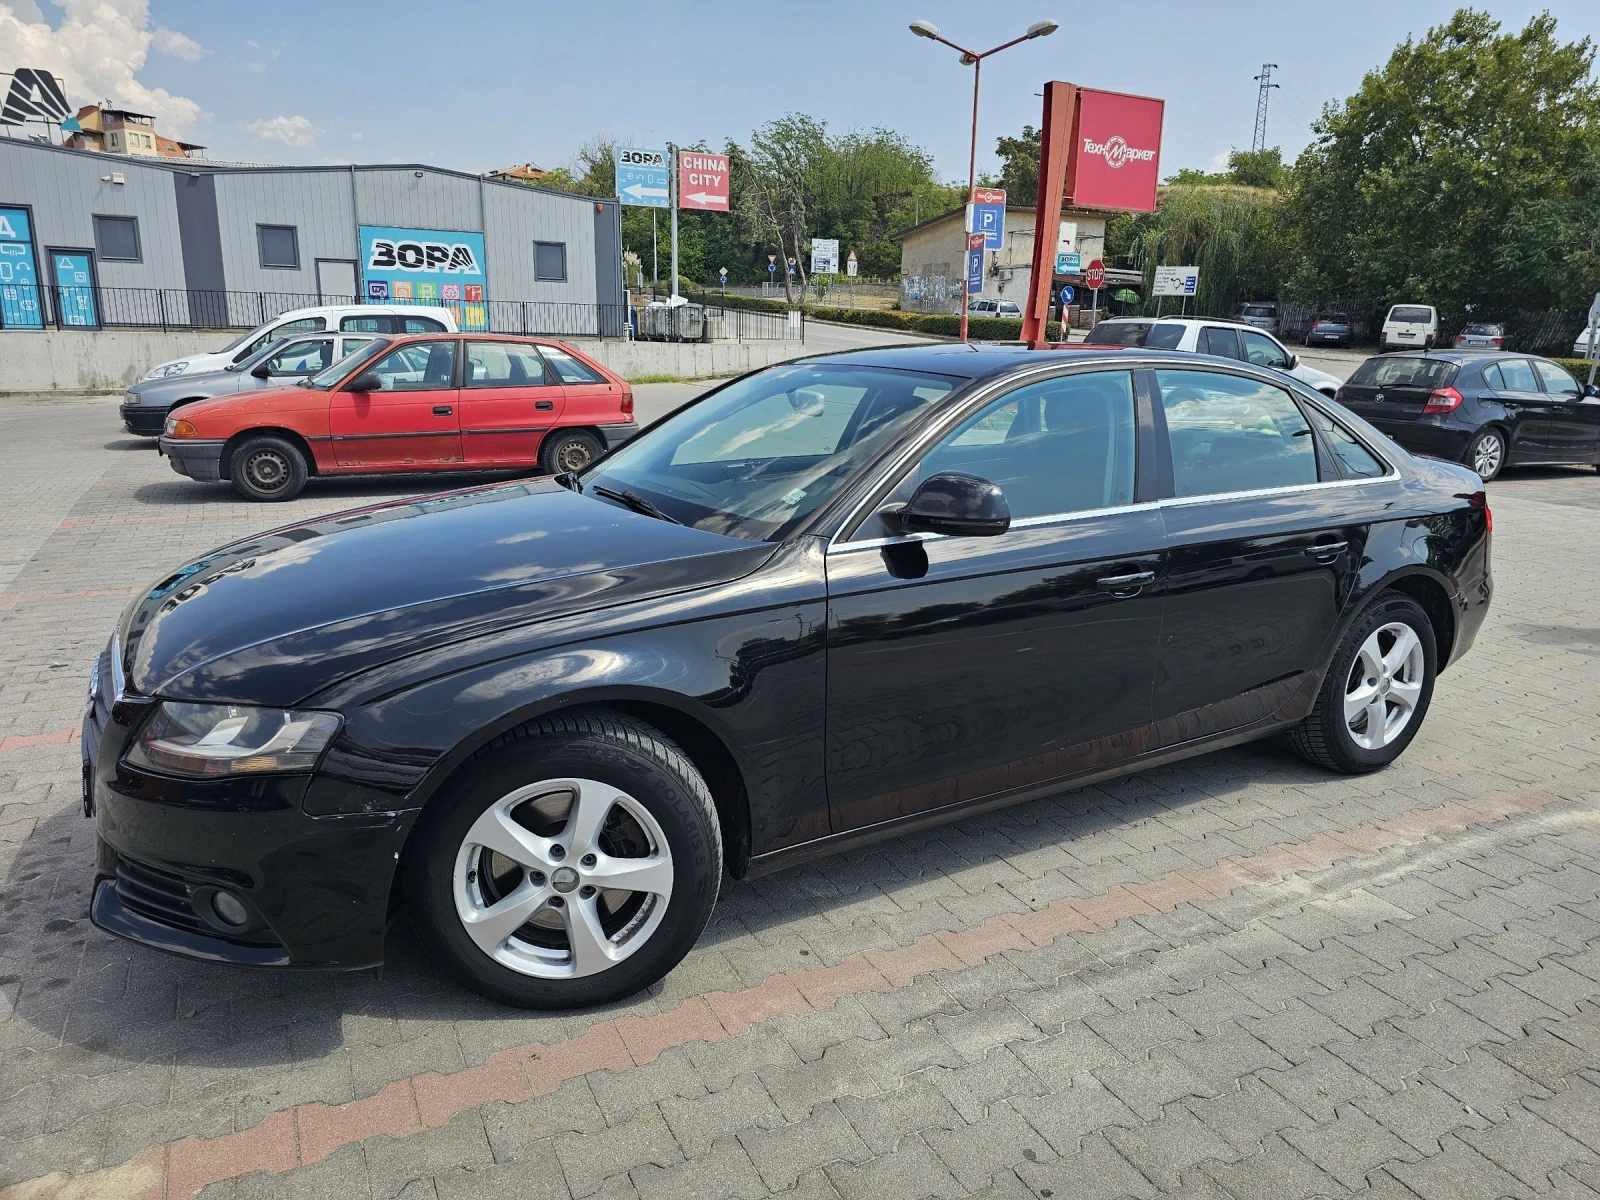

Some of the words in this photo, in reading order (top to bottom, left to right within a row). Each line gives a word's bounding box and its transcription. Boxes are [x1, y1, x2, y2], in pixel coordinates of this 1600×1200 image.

[683, 157, 727, 172] CHINA
[689, 173, 721, 187] CITY
[983, 213, 993, 228] P
[370, 241, 479, 273] ЗОРА
[973, 258, 979, 272] P
[1087, 268, 1104, 281] STOP
[655, 779, 704, 852] POLARIS
